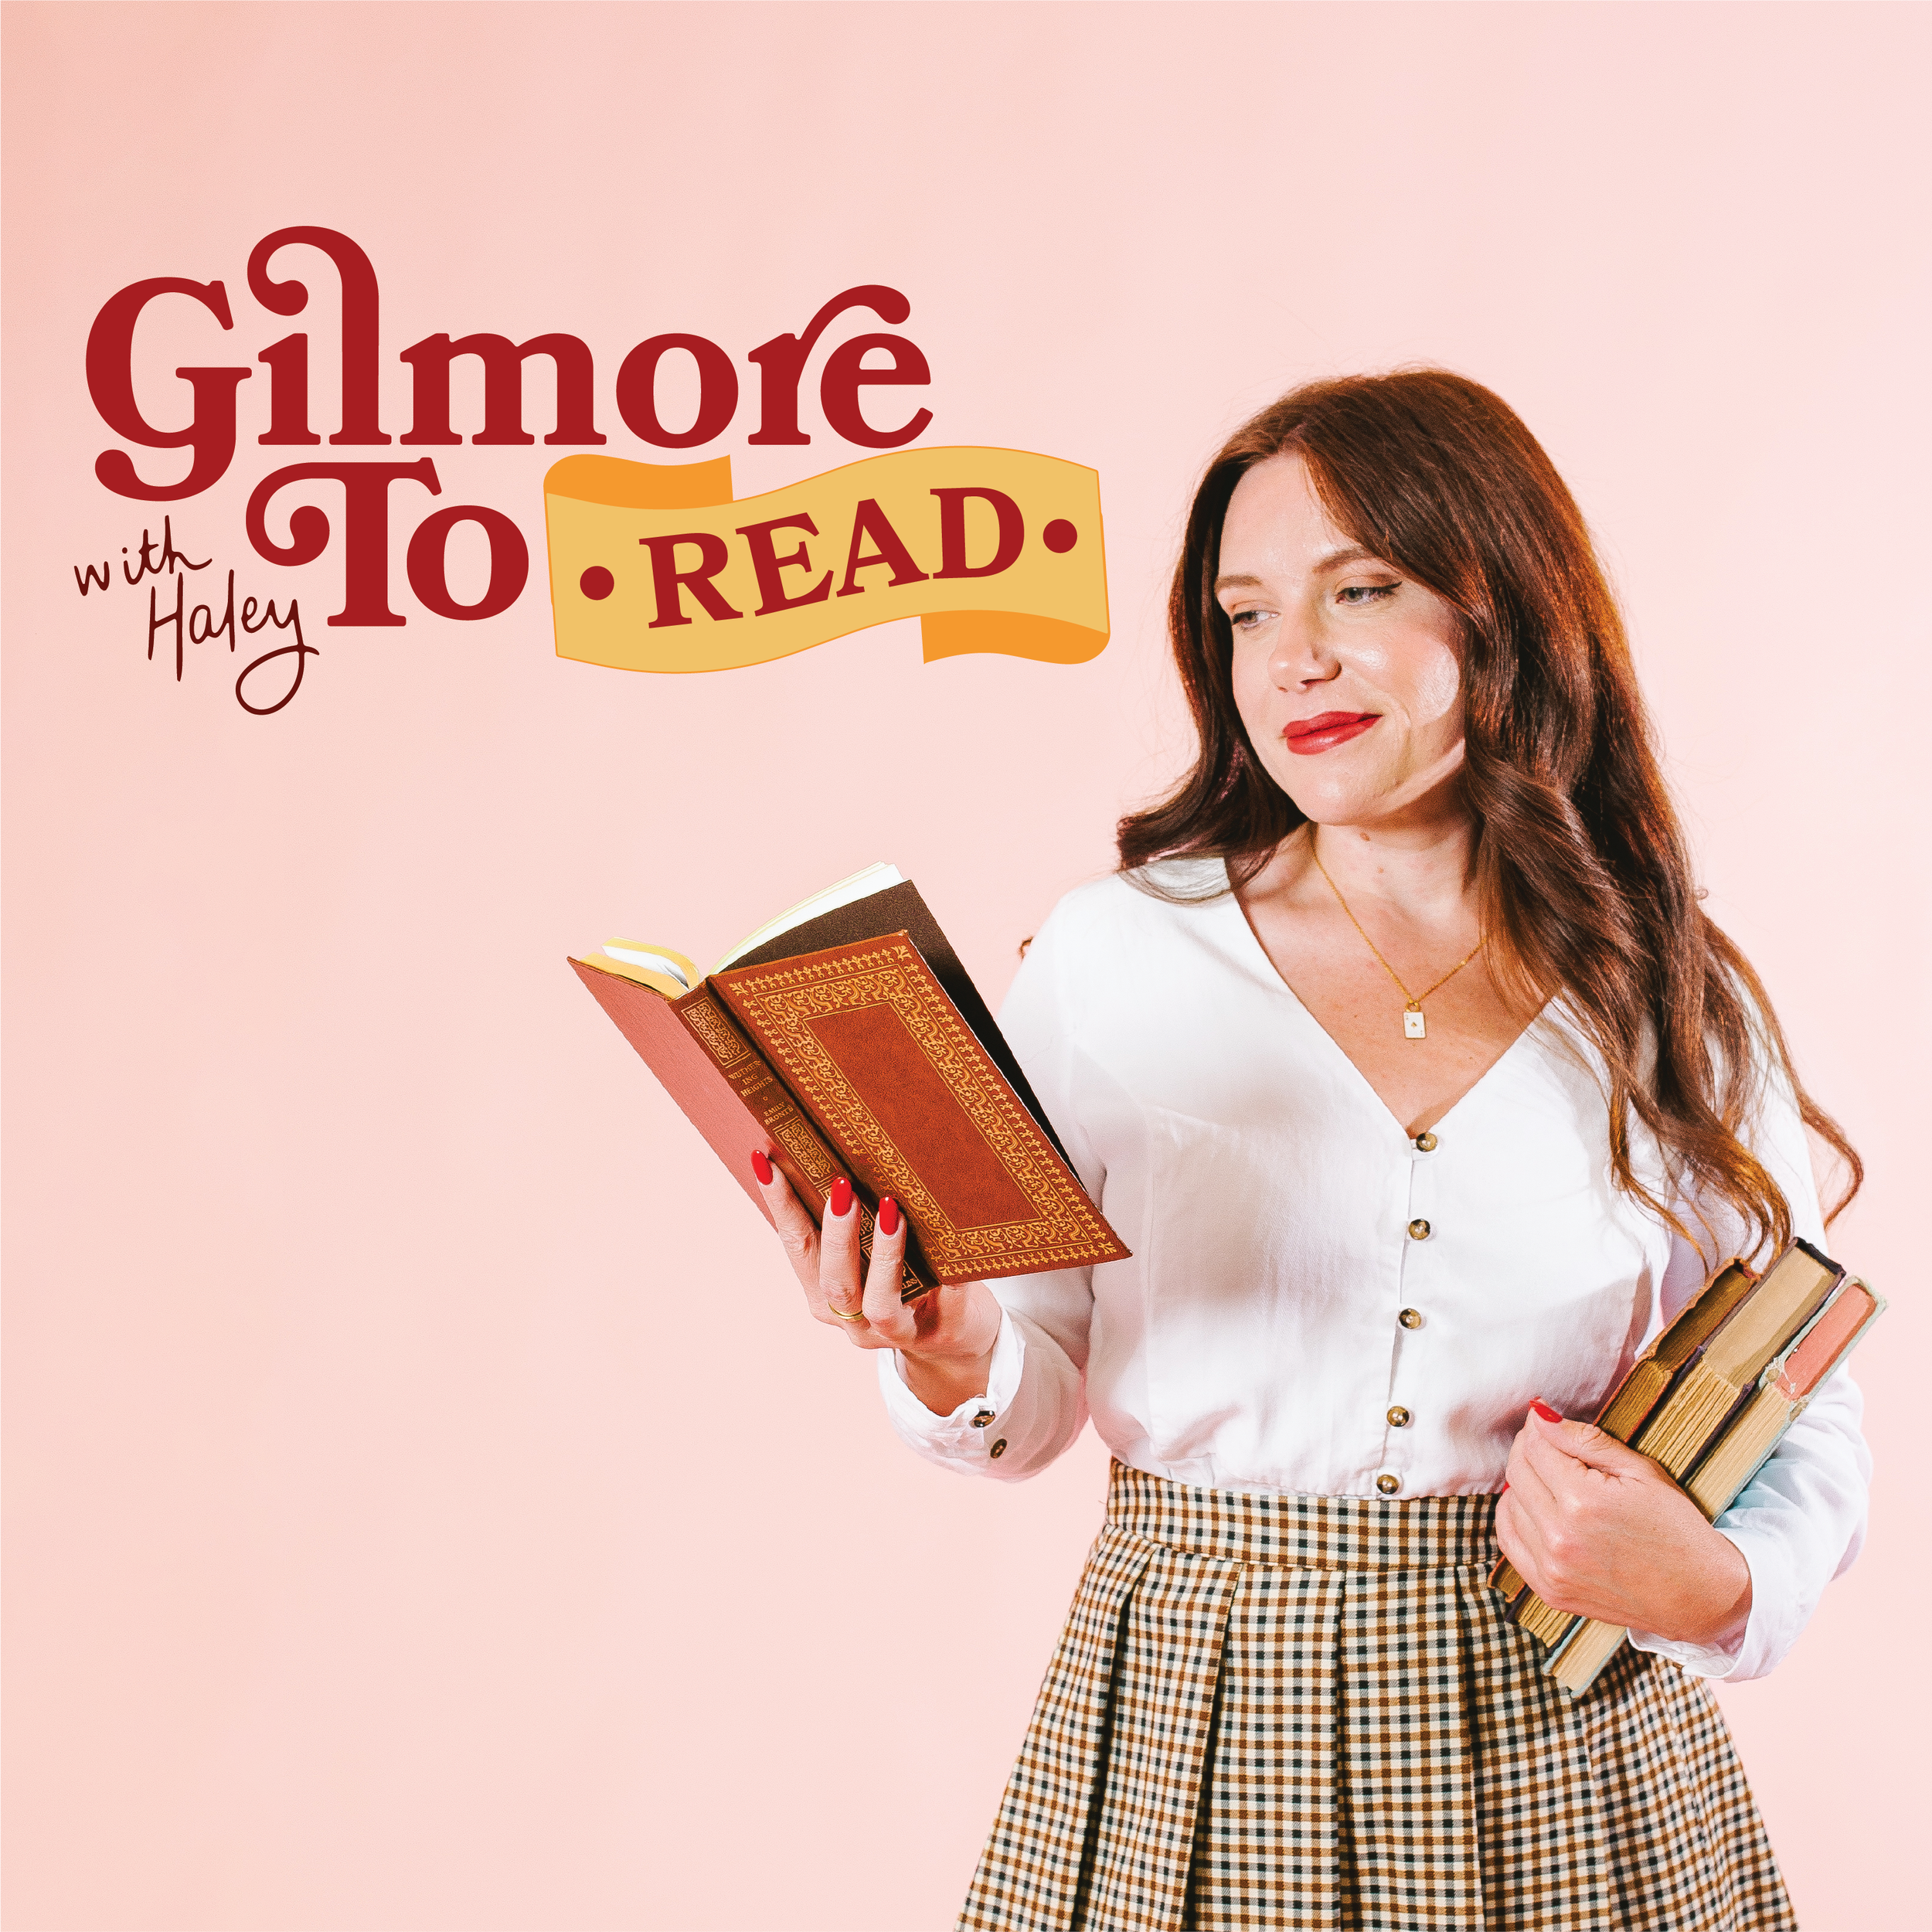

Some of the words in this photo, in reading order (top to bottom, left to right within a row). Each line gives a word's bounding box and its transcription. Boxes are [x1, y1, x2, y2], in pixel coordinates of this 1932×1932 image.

[740, 1076, 773, 1097] HEIGHTS
[742, 1073, 758, 1085] ING
[764, 1101, 785, 1117] EMILY
